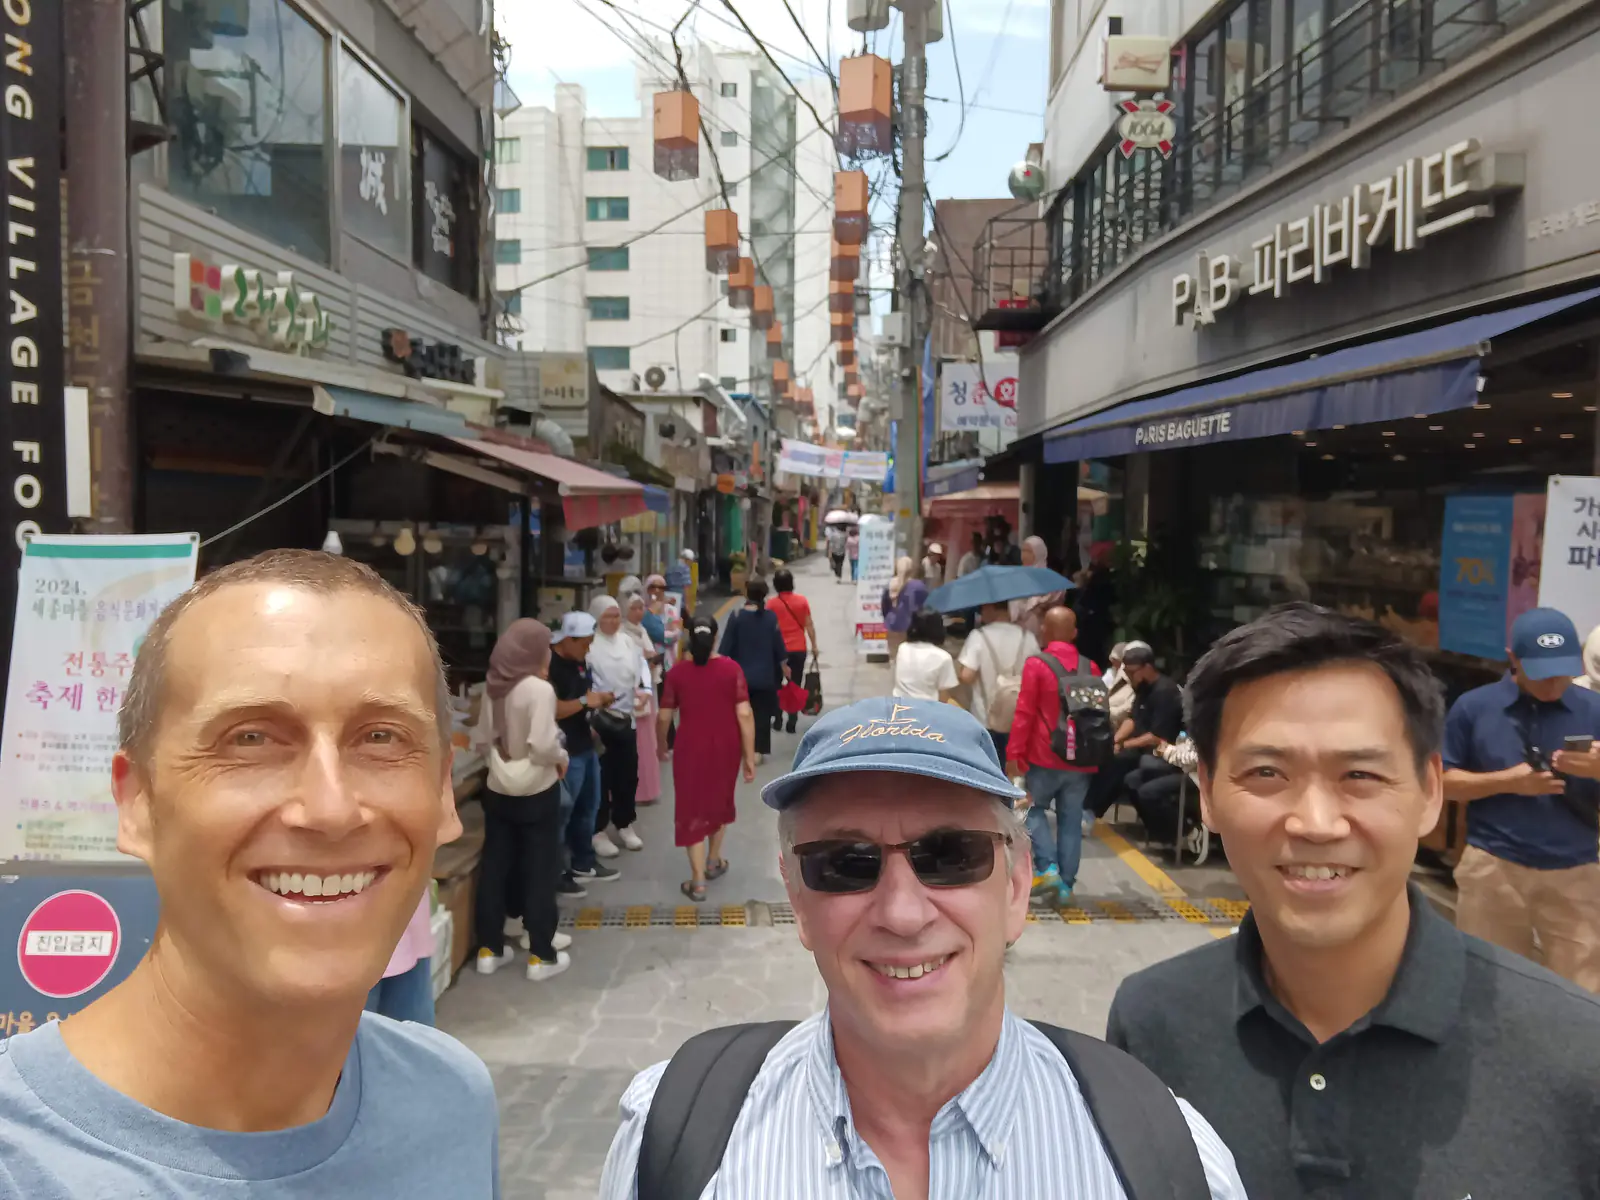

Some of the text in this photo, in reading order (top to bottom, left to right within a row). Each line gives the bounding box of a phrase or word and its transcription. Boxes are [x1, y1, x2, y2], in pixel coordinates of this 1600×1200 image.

[1248, 138, 1485, 299] 파리바게뜨
[8, 157, 38, 404] VILLAGE
[1135, 411, 1231, 445] PARIS BAGUETTE
[25, 681, 128, 713] 축제 한
[839, 723, 947, 748] Florida
[36, 935, 104, 953] 진입금지
